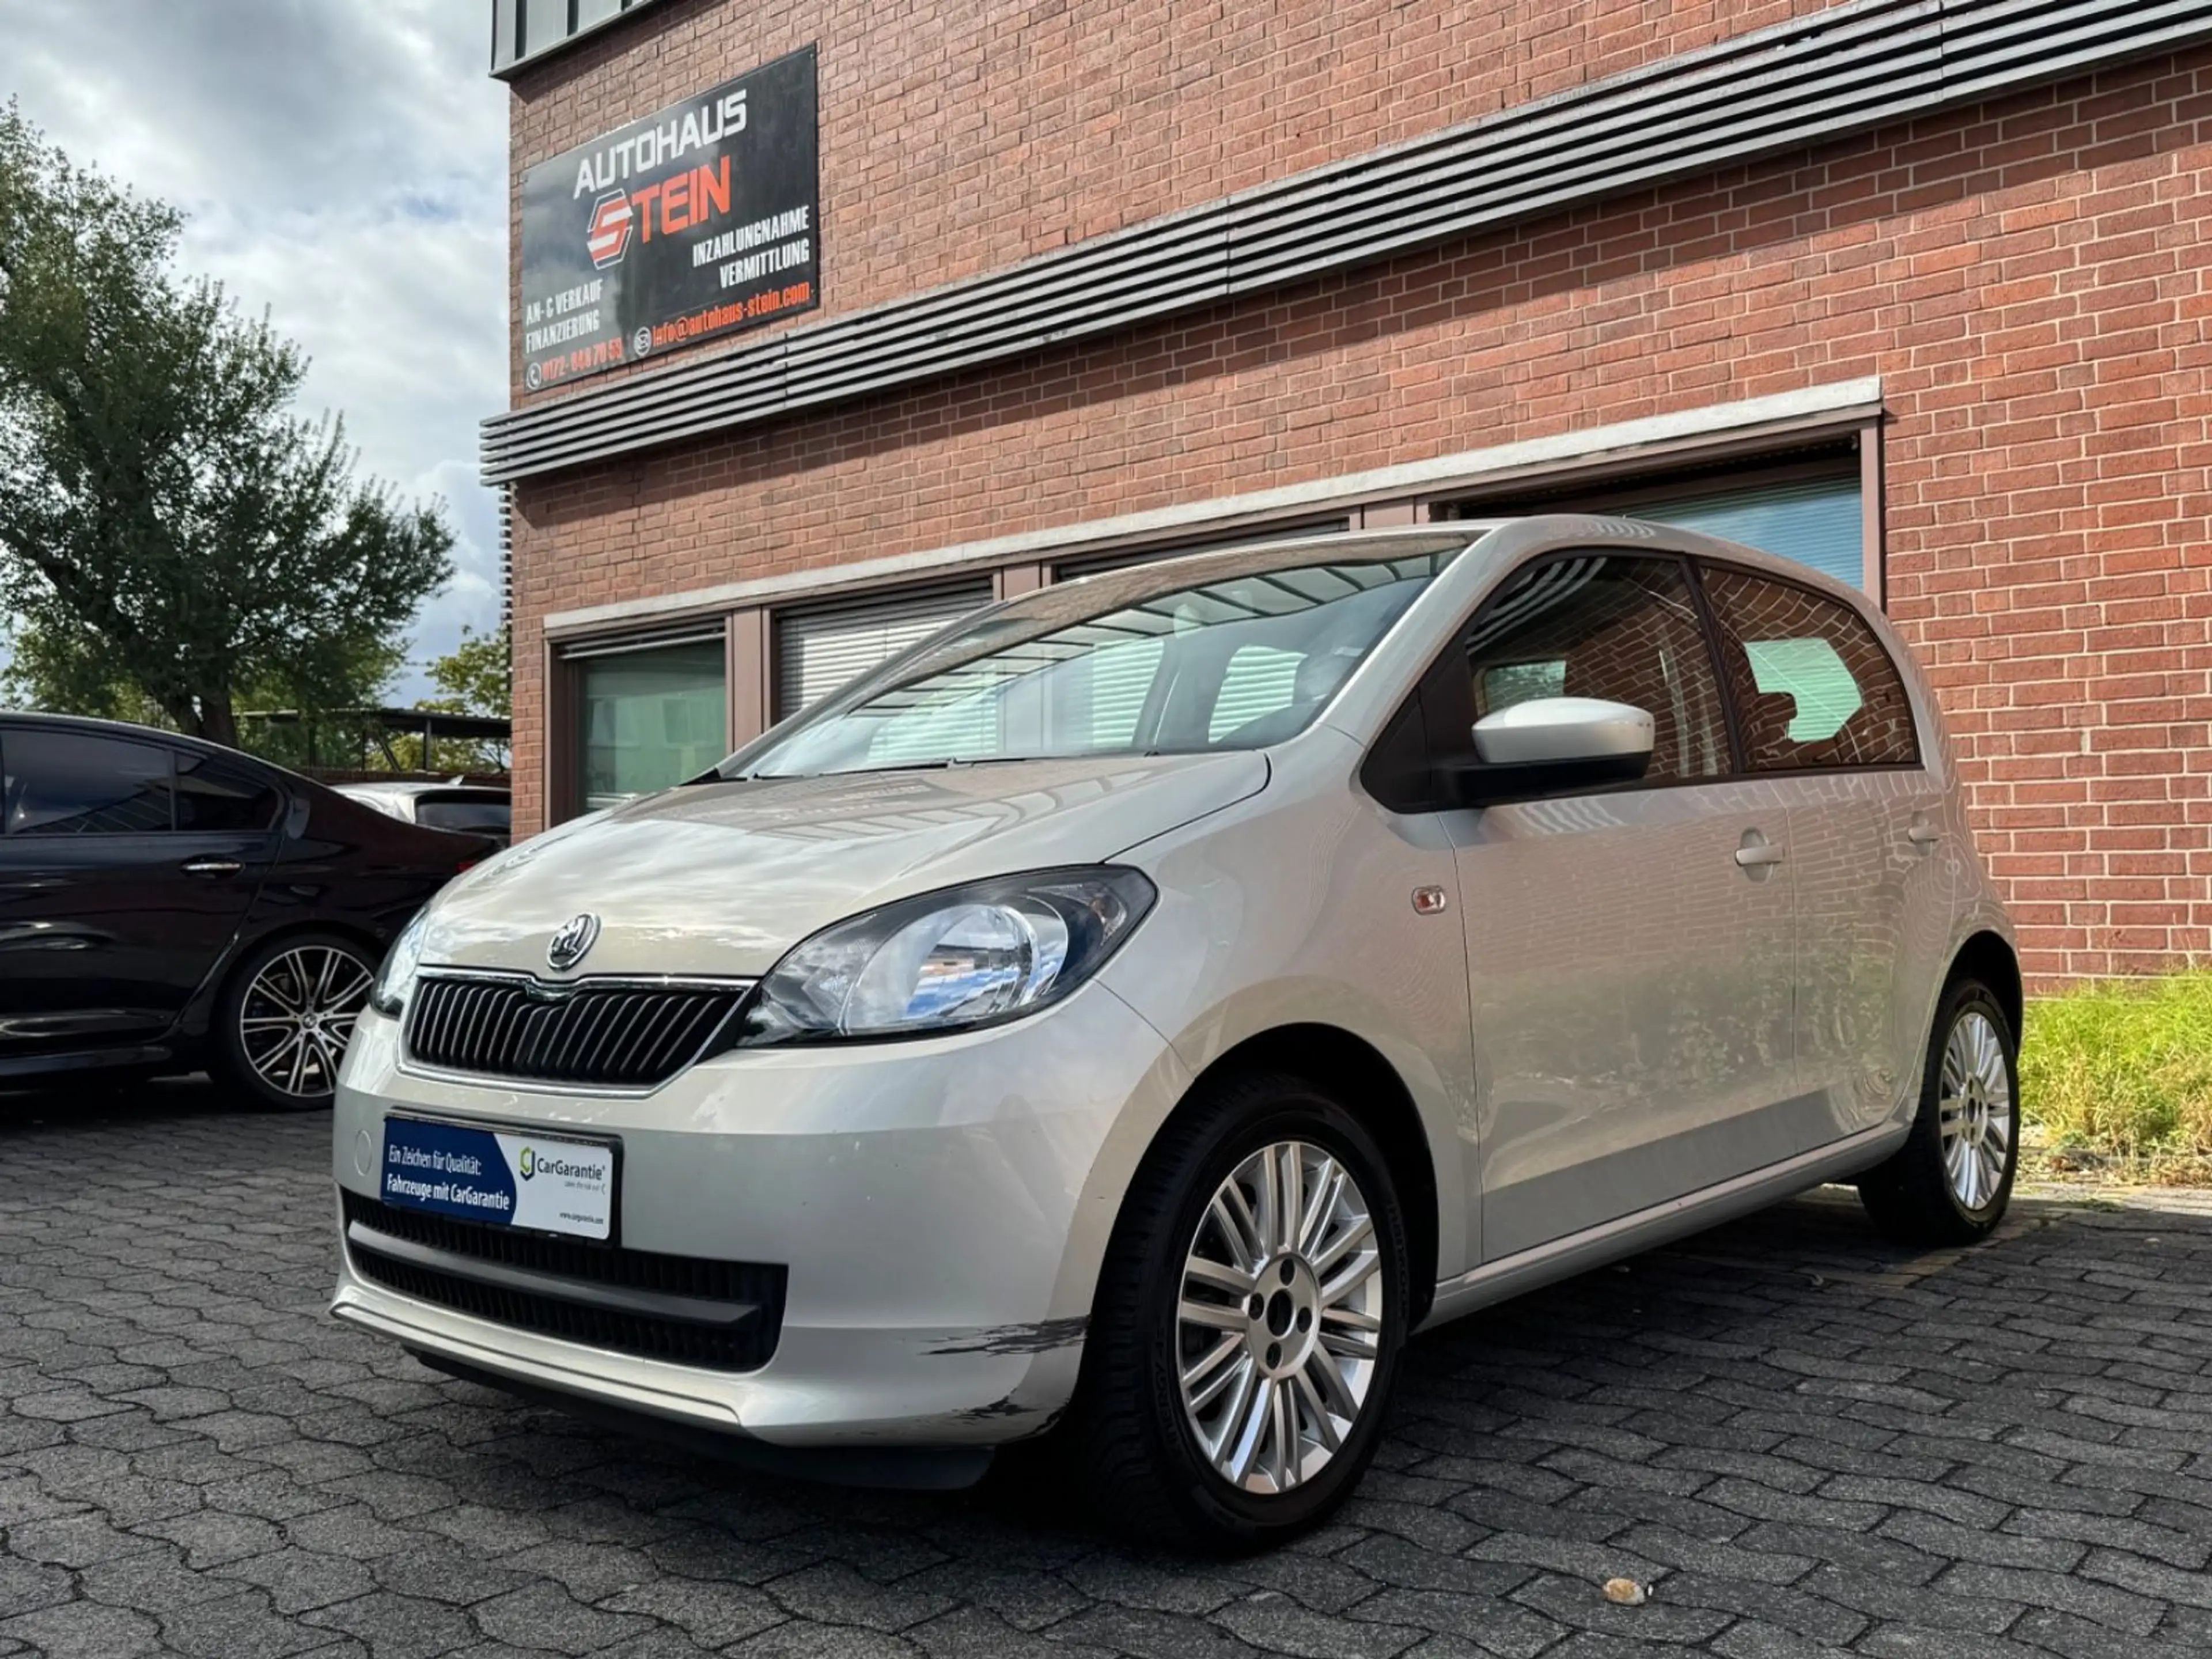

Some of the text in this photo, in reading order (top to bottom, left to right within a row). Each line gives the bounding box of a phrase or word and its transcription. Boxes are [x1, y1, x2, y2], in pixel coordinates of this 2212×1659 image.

[573, 89, 747, 200] AUTOHAUS
[587, 154, 731, 270] STEIN
[692, 204, 810, 267] INZAHLUNGNAHME
[719, 238, 810, 289] VERMITTLUNG
[555, 278, 603, 315] VERKAUF
[652, 282, 810, 347] info@autohaus-stein.com
[526, 309, 600, 355] FINANZIERUNG
[388, 1144, 482, 1176] Ein Zeichen für Qualität:
[387, 1173, 510, 1210] Fahrzeuge mit CarGarantie
